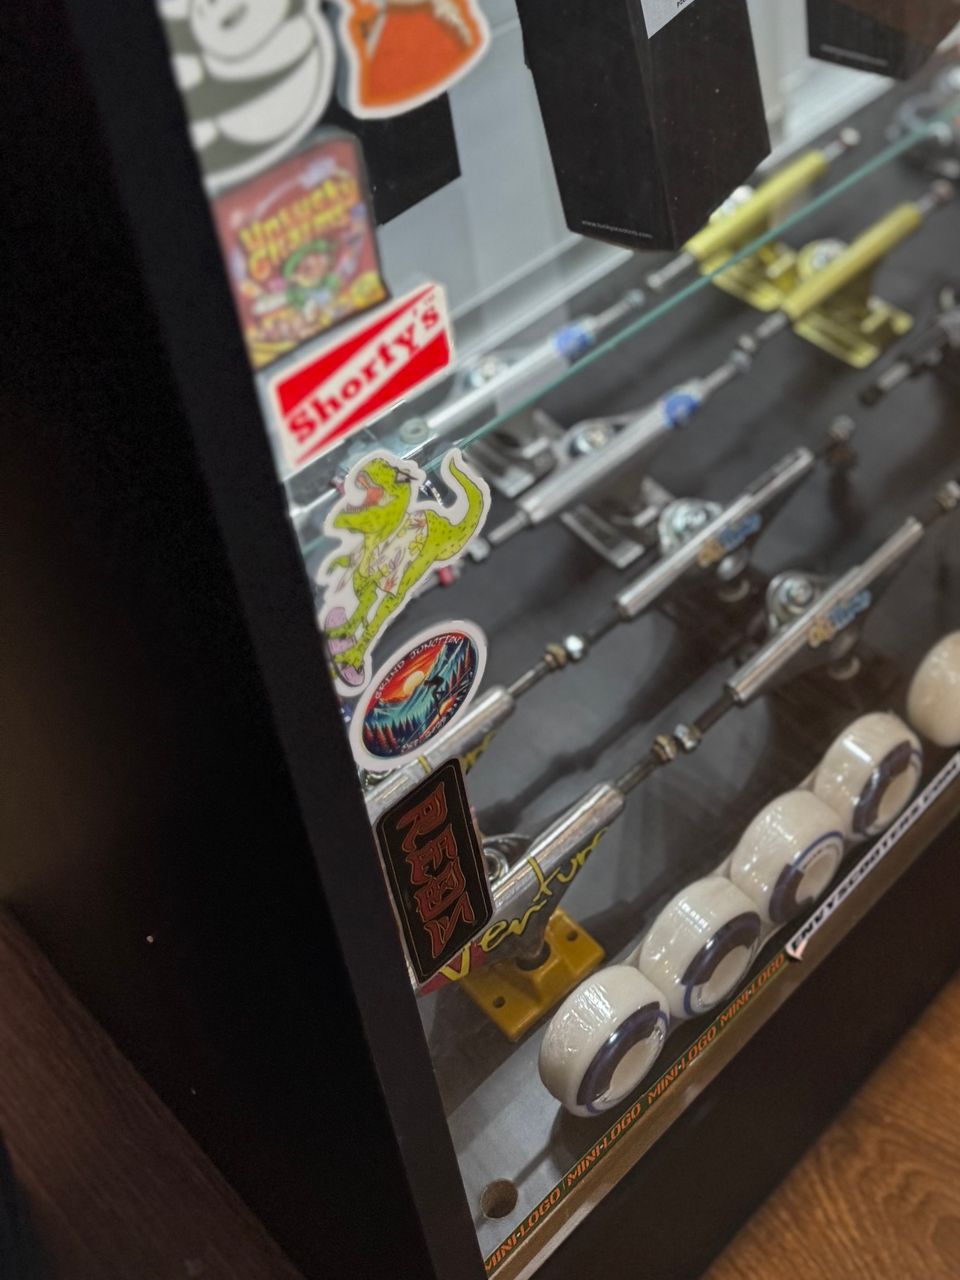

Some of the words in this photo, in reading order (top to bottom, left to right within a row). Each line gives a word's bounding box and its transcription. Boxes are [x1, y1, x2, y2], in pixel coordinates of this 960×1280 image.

[289, 306, 440, 445] Shorty's
[375, 660, 406, 700] GRIND
[409, 634, 463, 659] JUNCTION
[567, 1102, 641, 1186] MINI-LOGO
[647, 1026, 717, 1104] MINI-LOGO
[720, 953, 785, 1026] MINI-LOGO
